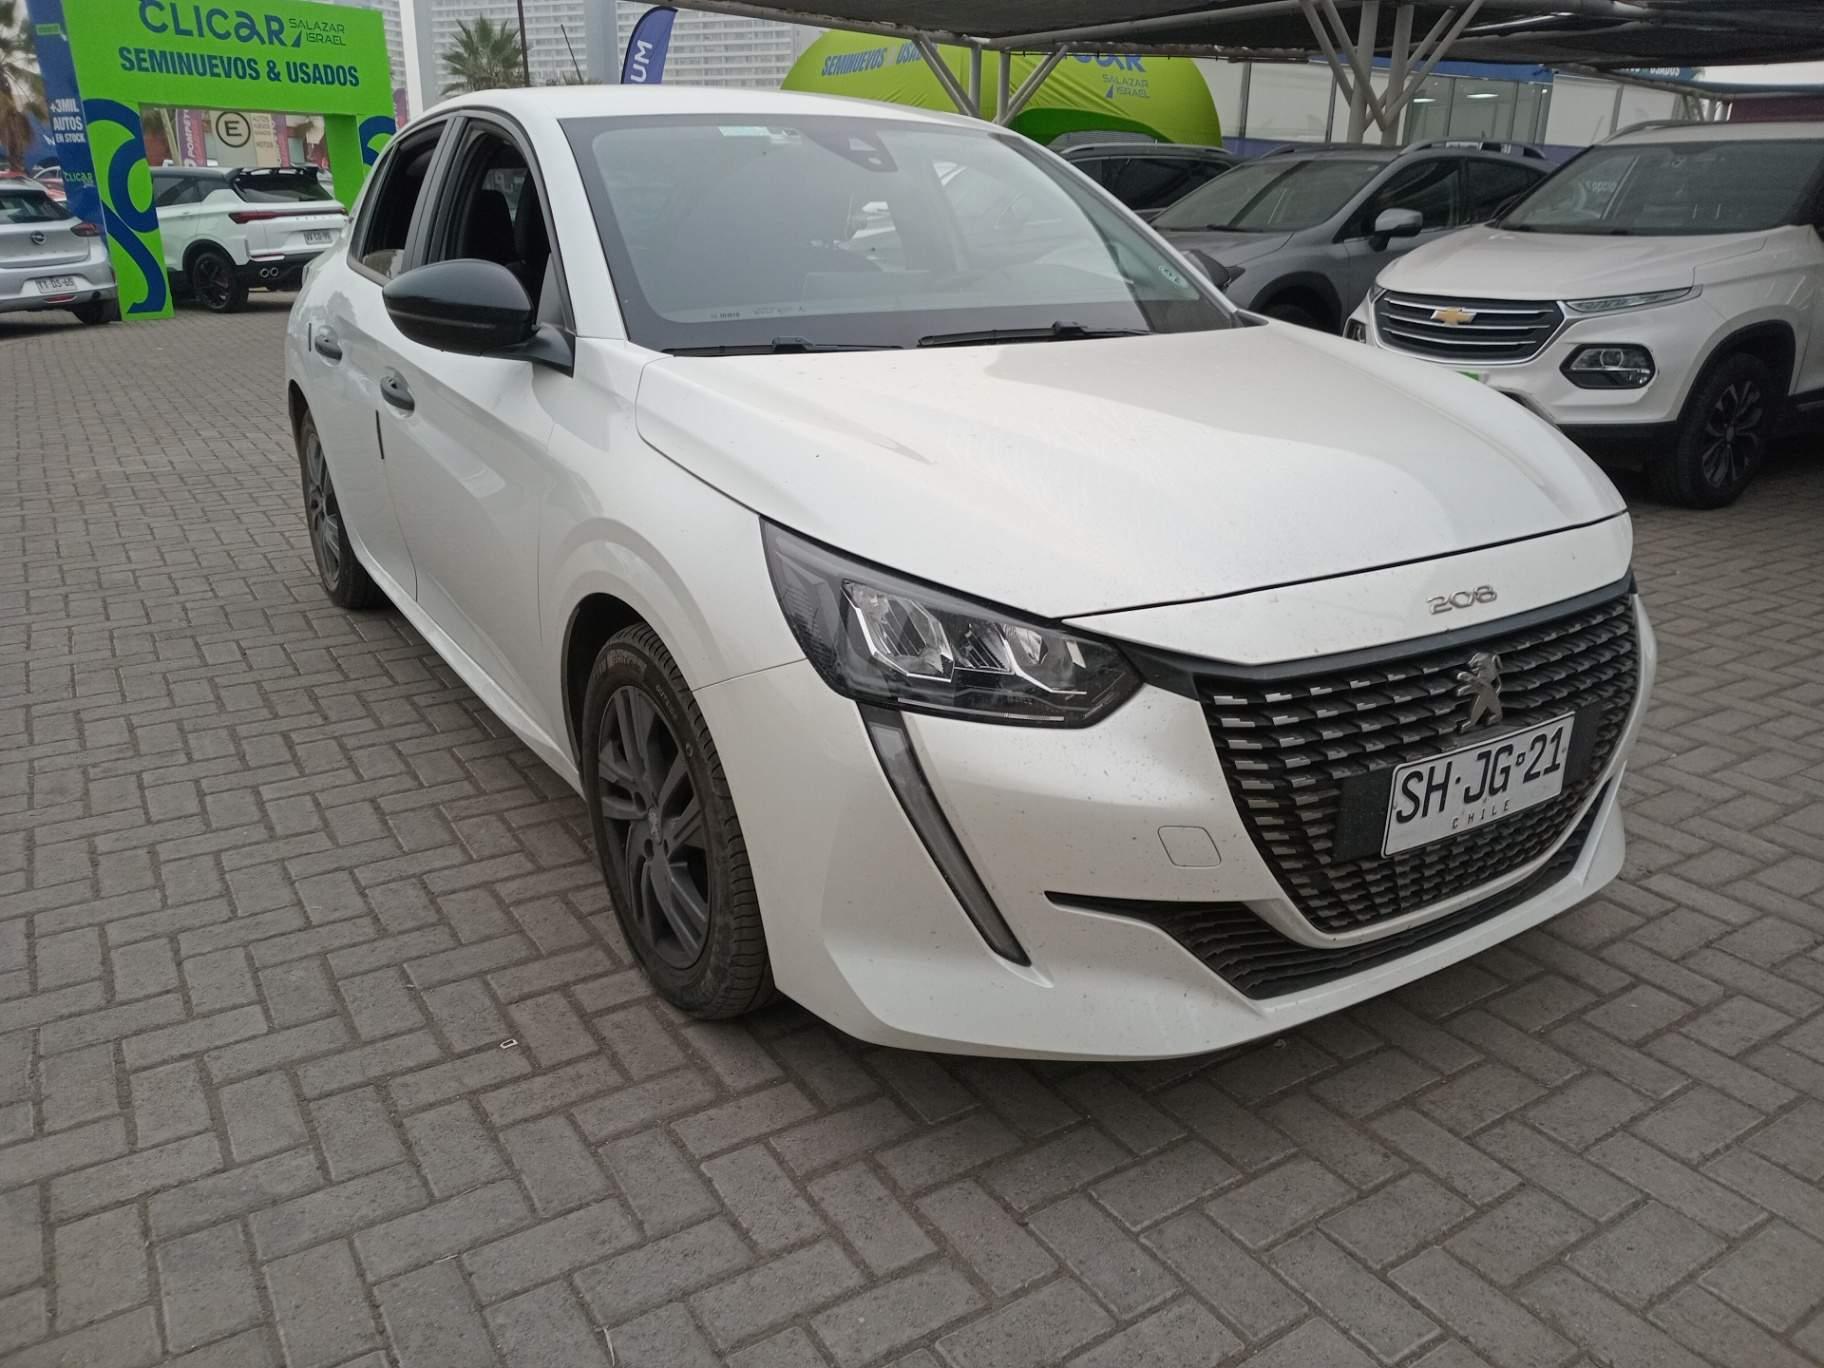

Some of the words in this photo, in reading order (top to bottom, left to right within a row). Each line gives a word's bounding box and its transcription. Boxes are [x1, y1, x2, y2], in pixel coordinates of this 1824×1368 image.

[288, 18, 345, 34] SALAZAR
[306, 32, 347, 46] ISRAEL
[118, 46, 260, 81] SEMINUEVOS
[266, 59, 282, 82] &
[286, 60, 360, 88] USADOS
[50, 98, 80, 113] +3MIL
[53, 116, 84, 131] AUTOS
[224, 120, 243, 137] E
[1426, 584, 1498, 615] 208
[1451, 799, 1512, 830] CHILE
